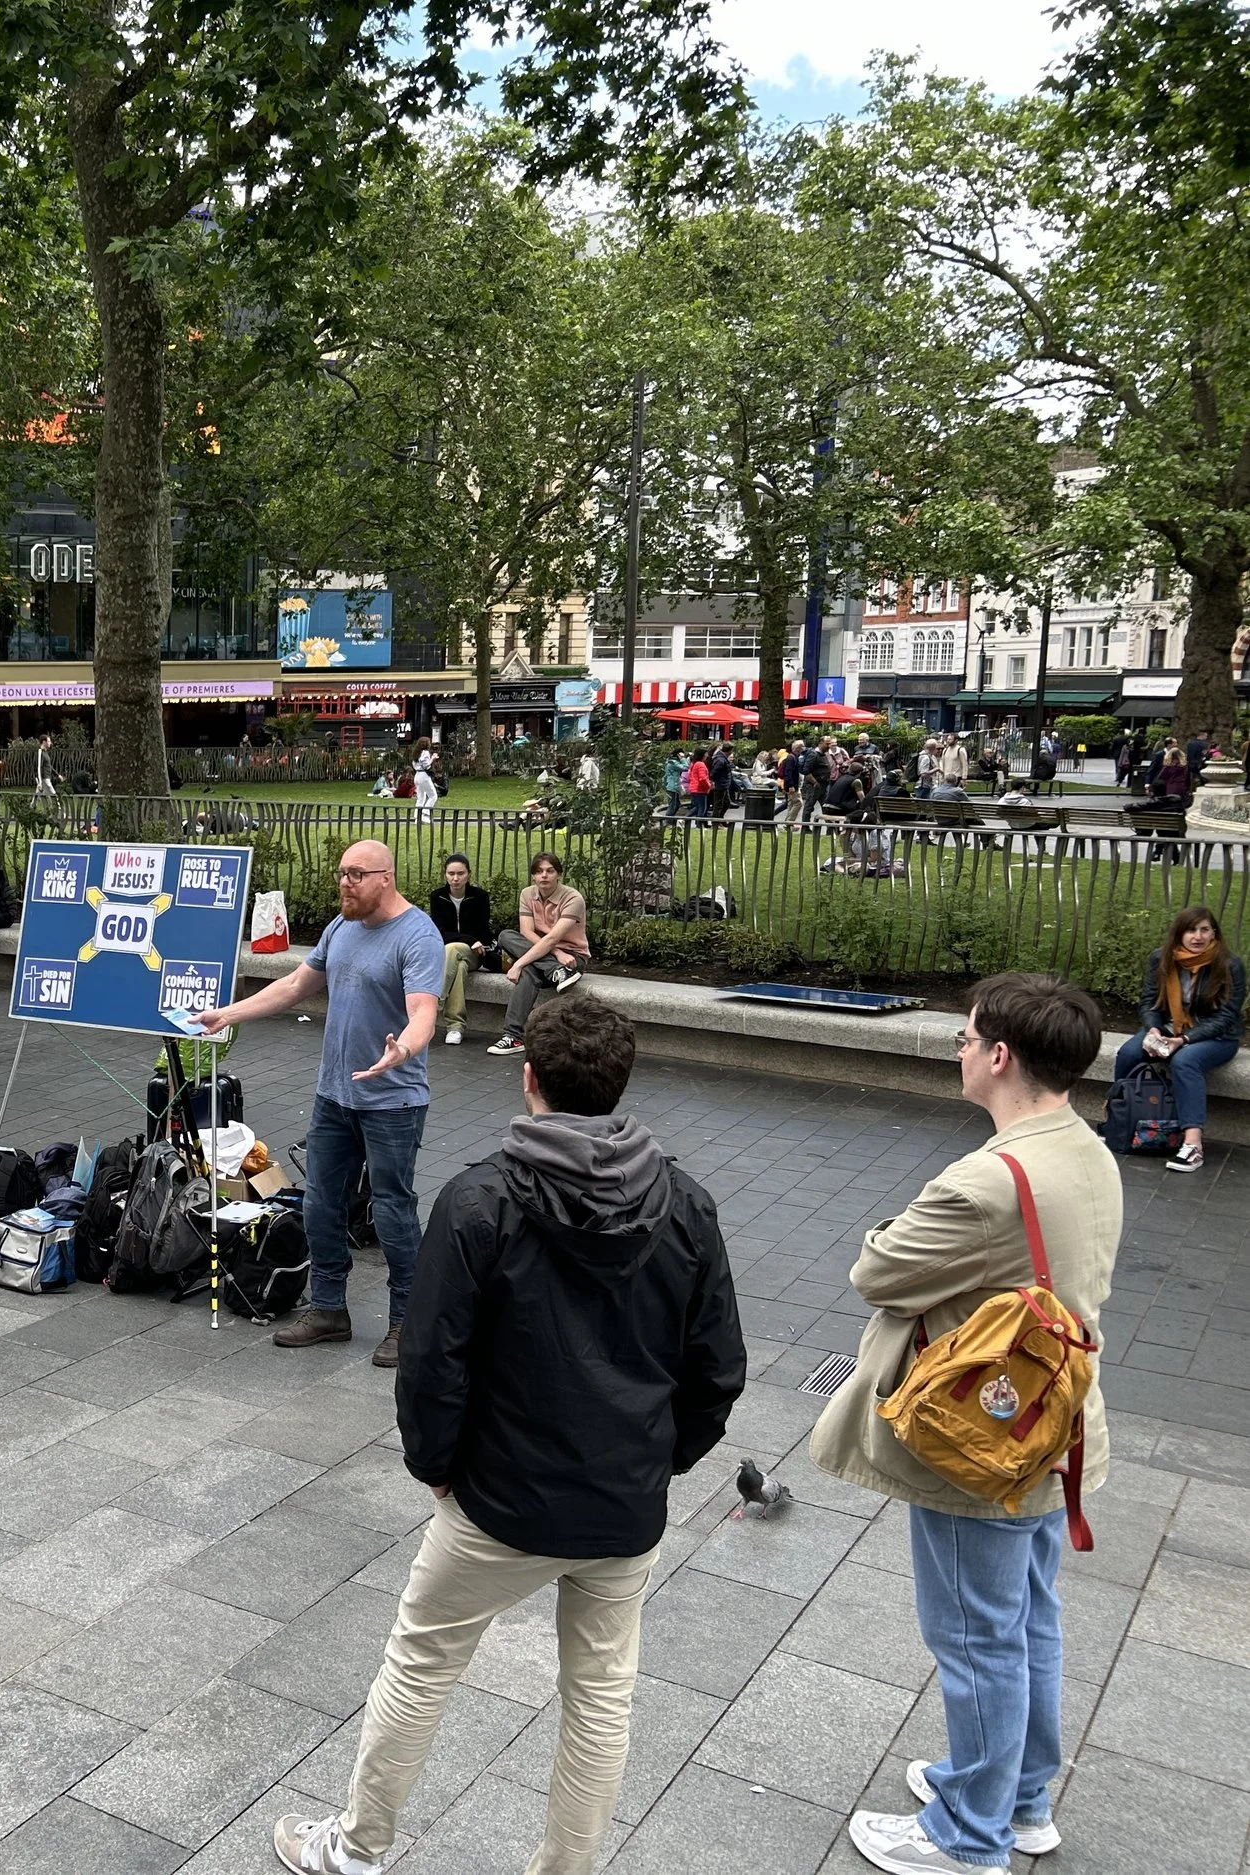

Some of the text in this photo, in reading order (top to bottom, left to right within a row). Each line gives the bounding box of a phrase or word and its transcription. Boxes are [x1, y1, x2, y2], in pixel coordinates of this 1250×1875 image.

[30, 543, 94, 583] ODE
[25, 687, 50, 697] LUXE
[52, 687, 95, 697] LEICESTE
[172, 685, 185, 695] OF
[187, 684, 235, 694] PREMIERES
[690, 689, 728, 699] FRIDAYS
[114, 852, 156, 868] Who is
[183, 858, 221, 871] ROSE TO
[44, 869, 78, 881] CAME AS
[111, 872, 155, 890] JESUS?
[180, 870, 220, 890] RULE
[41, 879, 76, 899] KING
[101, 914, 148, 943] GOD
[43, 970, 72, 981] DIED FOR
[165, 975, 218, 990] COMING TO
[39, 979, 71, 1004] SIN
[163, 988, 216, 1010] JUDGE
